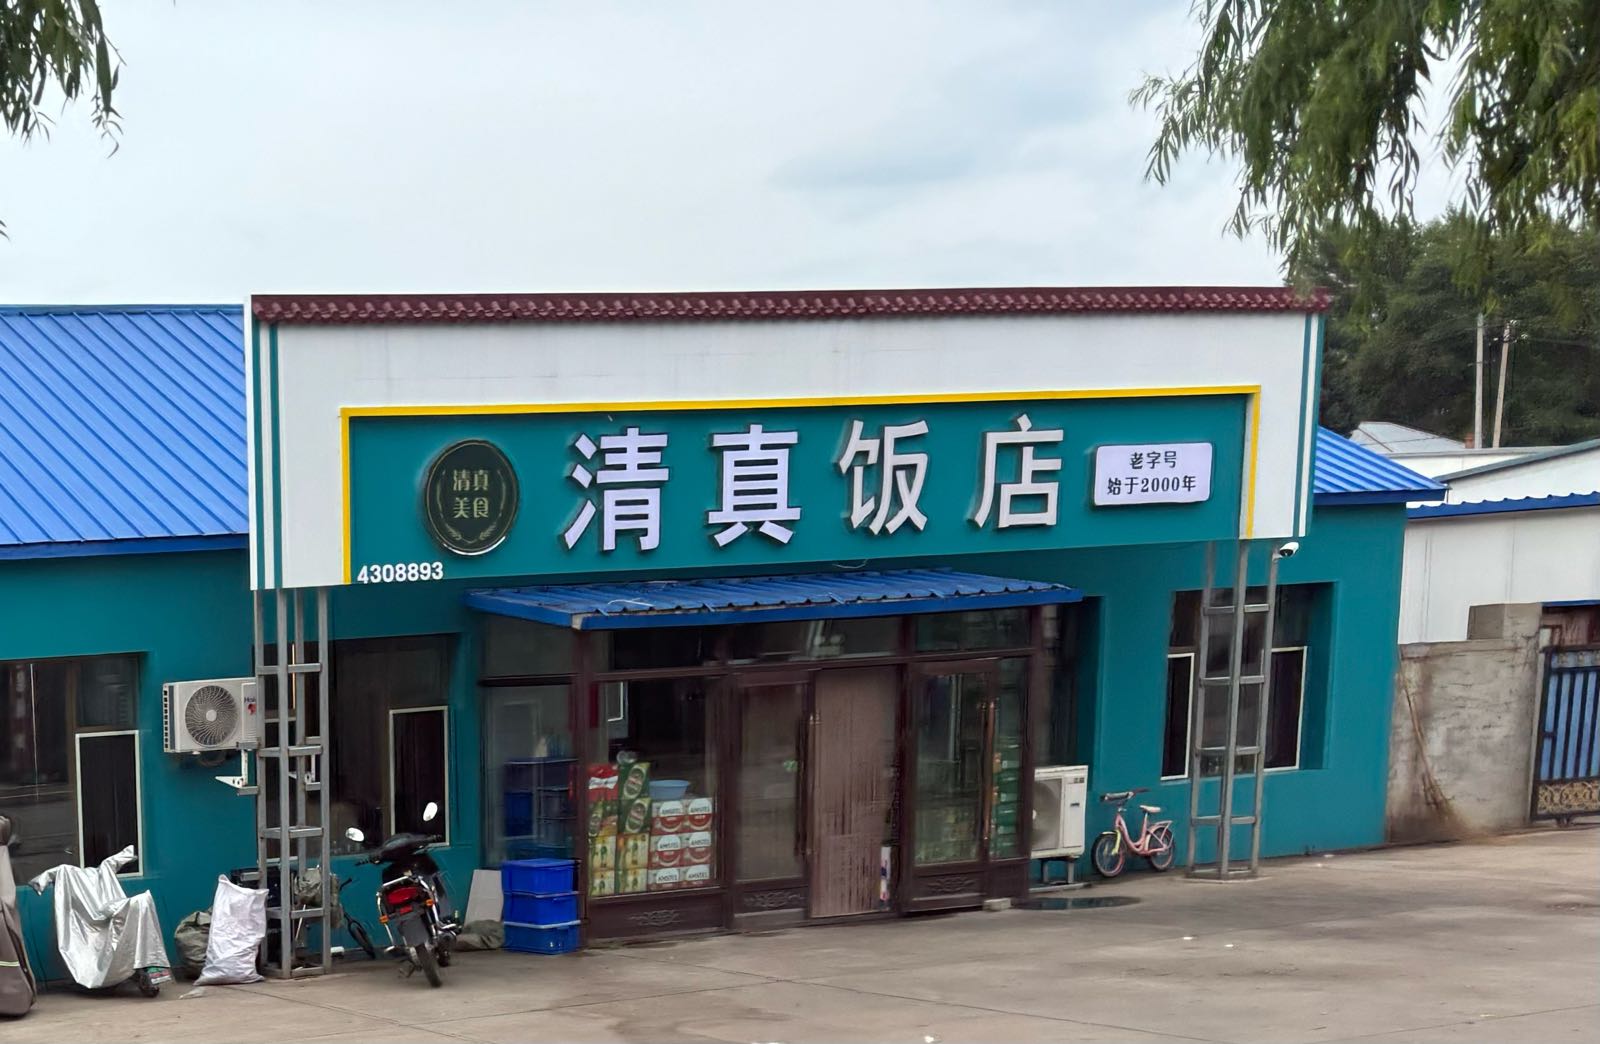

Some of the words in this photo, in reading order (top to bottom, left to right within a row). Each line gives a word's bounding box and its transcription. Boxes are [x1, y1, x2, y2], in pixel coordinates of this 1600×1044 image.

[1130, 450, 1177, 470] 老字号
[453, 469, 489, 491] 清真
[563, 414, 1064, 551] 清真饭店
[1107, 475, 1196, 495] 始于2000年
[453, 497, 489, 518] 美食
[357, 561, 444, 584] 4308893
